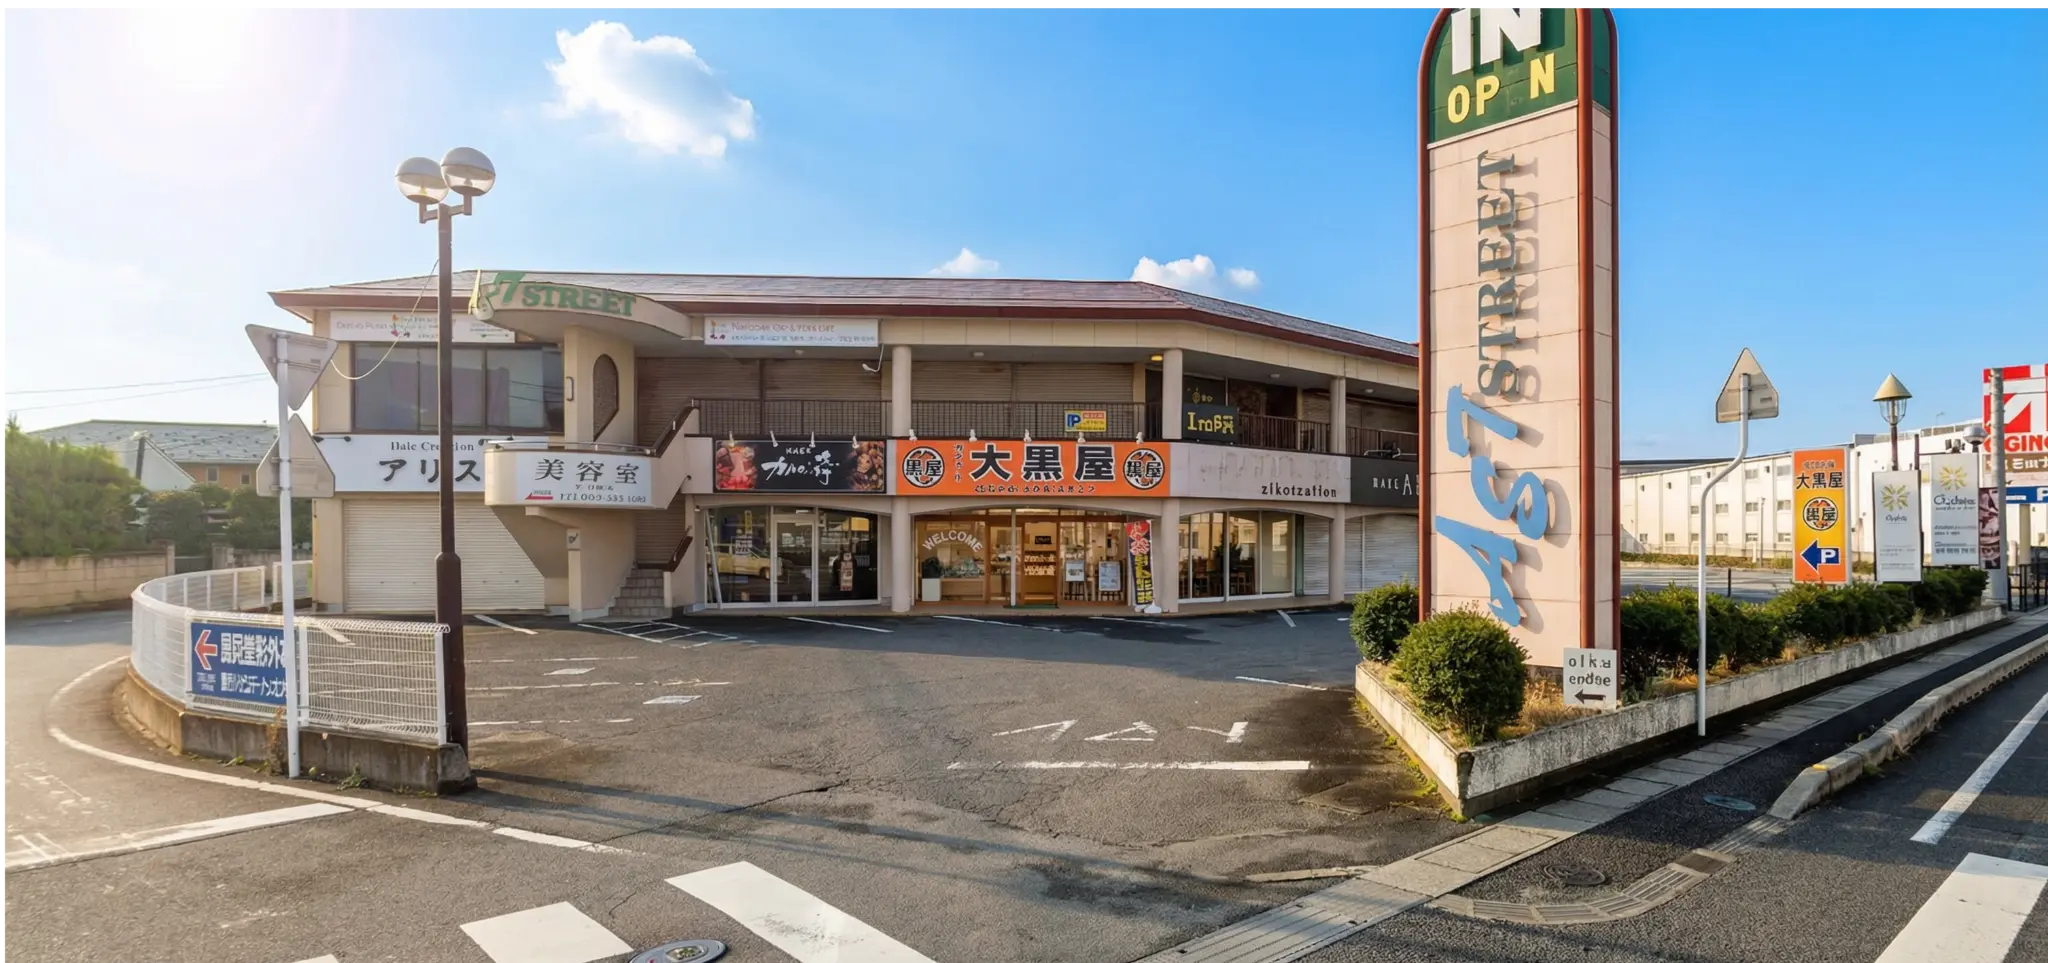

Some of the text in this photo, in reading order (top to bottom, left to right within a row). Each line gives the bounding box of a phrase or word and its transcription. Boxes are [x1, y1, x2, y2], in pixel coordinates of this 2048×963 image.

[1477, 150, 1519, 397] STREET
[522, 284, 637, 316] STREET
[379, 459, 480, 483] アリス
[535, 458, 639, 484] 美容室
[969, 443, 1115, 481] 大黒屋
[1796, 472, 1843, 490] 大黒屋
[922, 530, 984, 553] WELCOME
[1820, 549, 1837, 564] P
